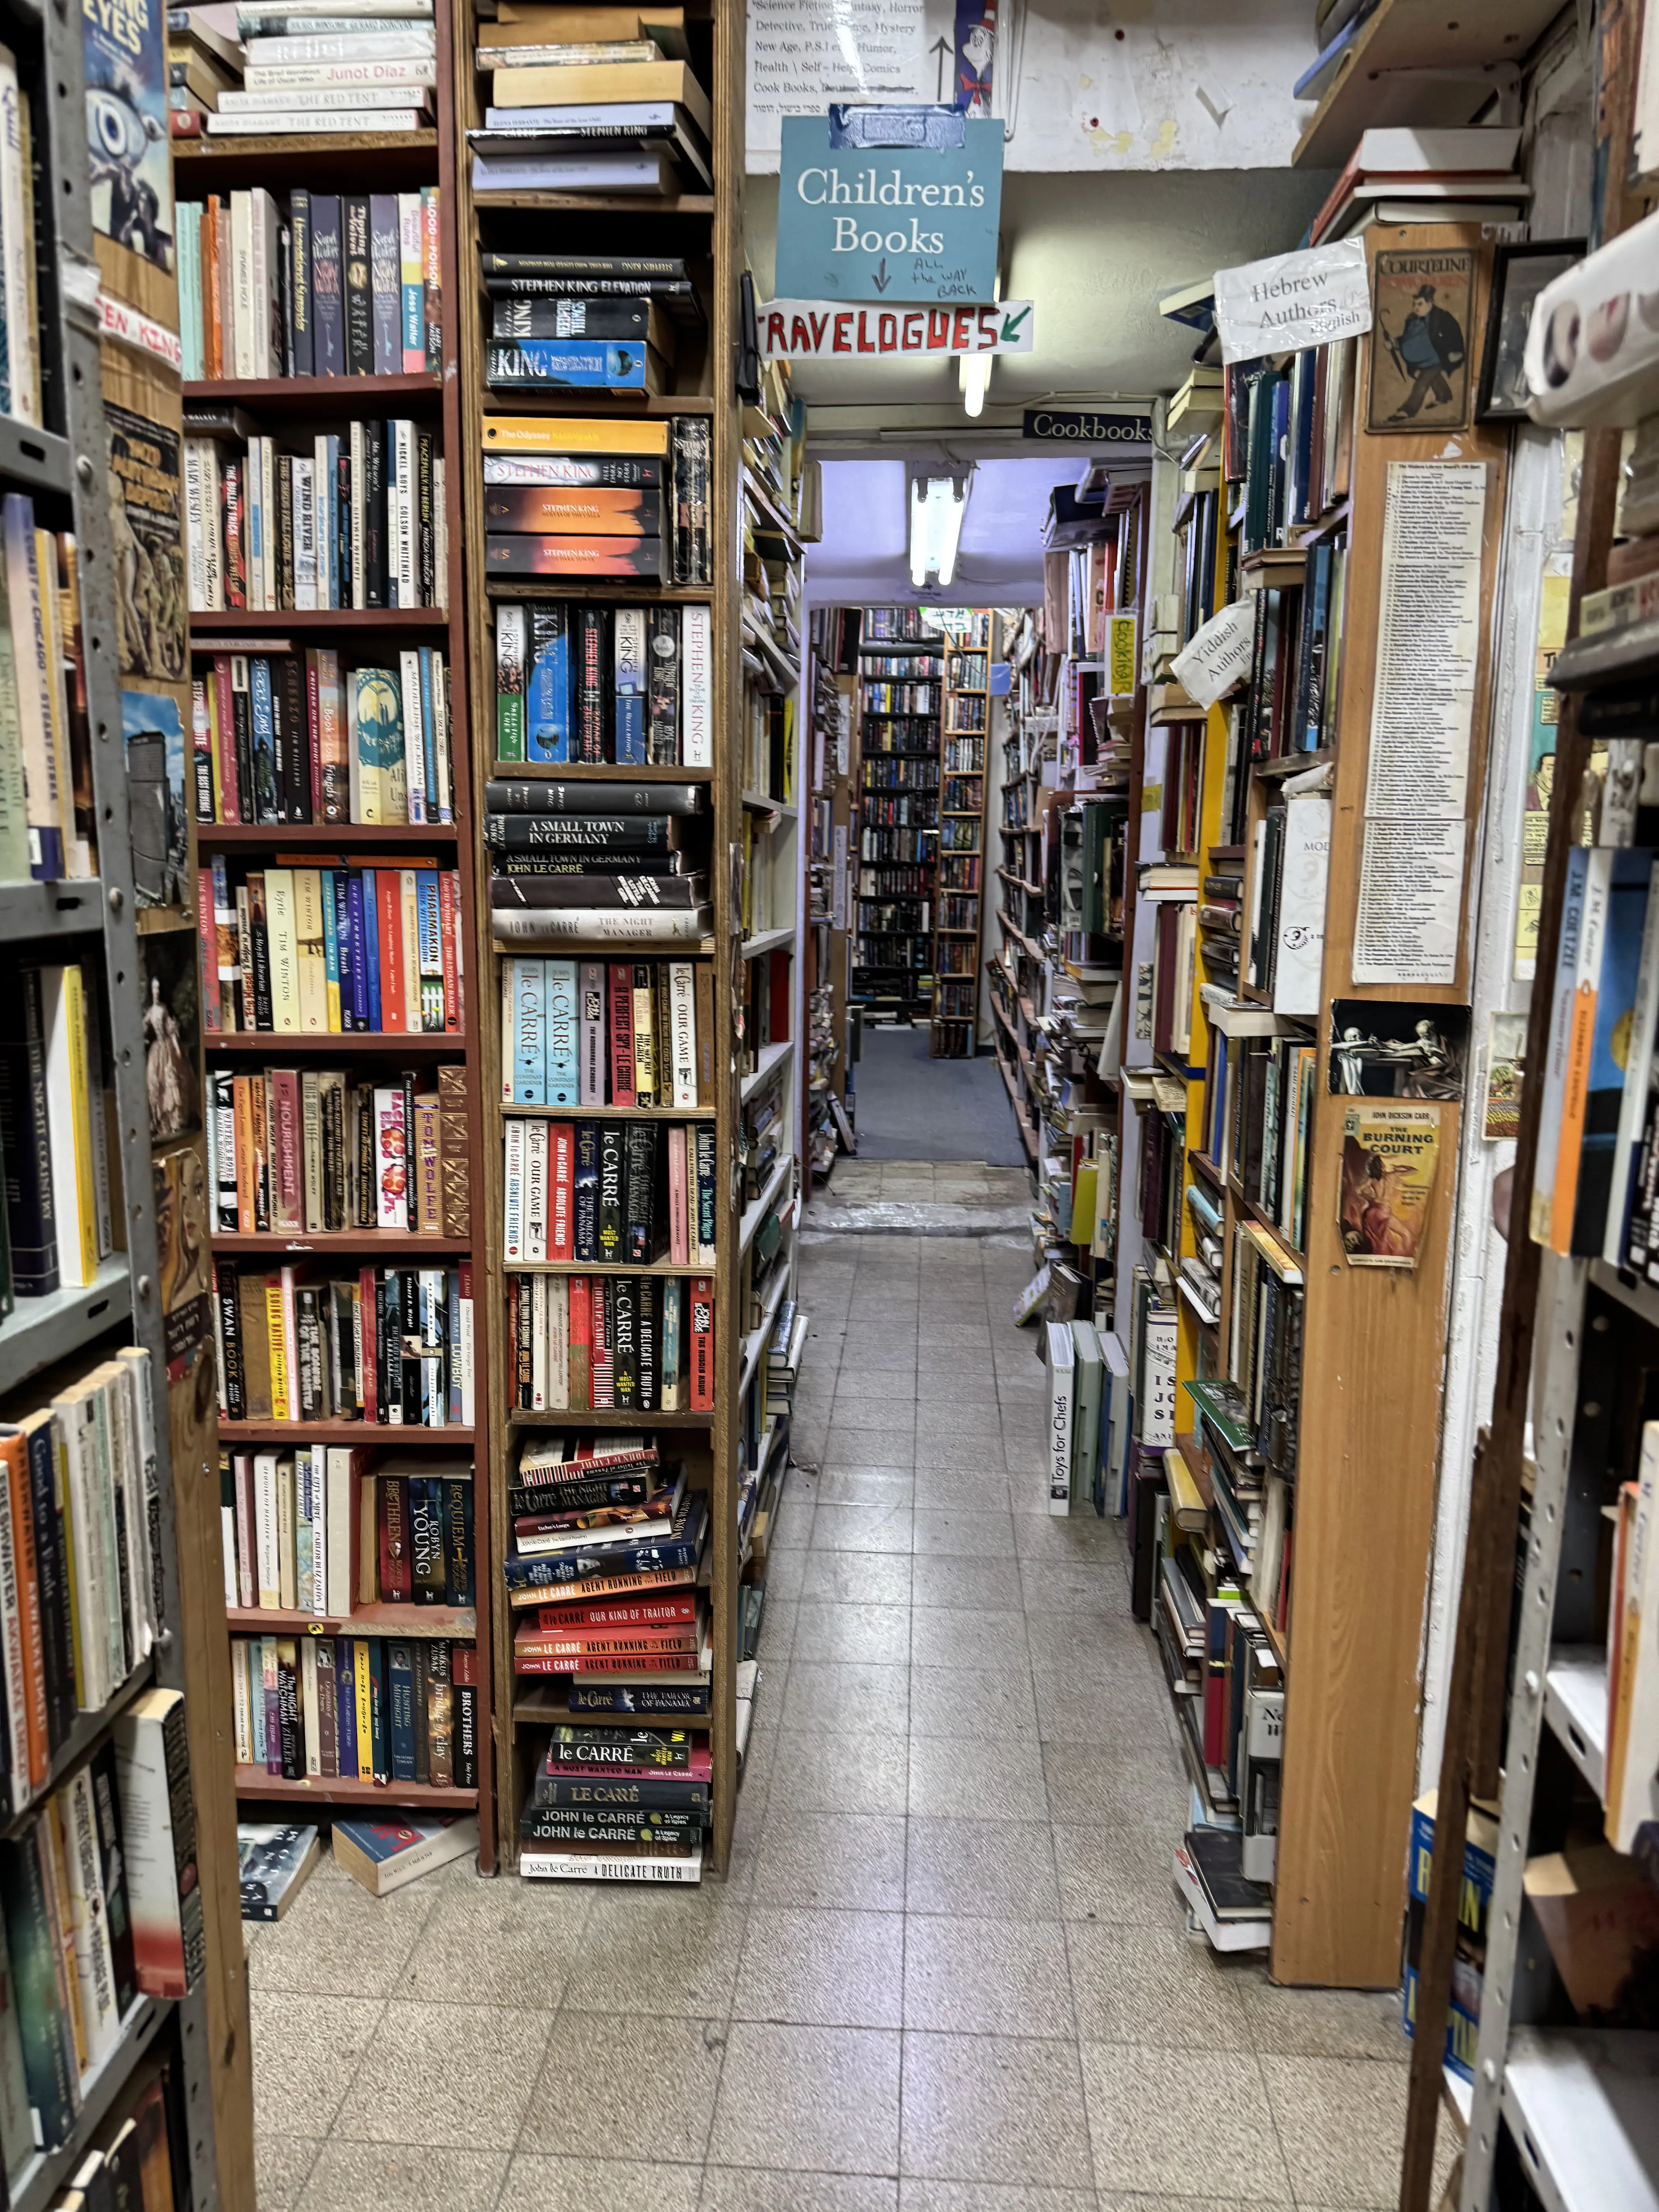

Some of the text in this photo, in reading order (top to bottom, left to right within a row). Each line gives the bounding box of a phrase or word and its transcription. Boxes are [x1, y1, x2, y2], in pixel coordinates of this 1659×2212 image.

[755, 60, 788, 72] Health
[754, 82, 779, 93] Cook
[798, 168, 985, 207] Children's
[831, 217, 944, 254] Books
[512, 279, 651, 295] STEPHEN KING ELEVATION
[937, 284, 977, 298] BACK
[1251, 271, 1328, 303] Hebrew
[513, 299, 532, 338] KING
[757, 306, 1001, 354] RAVELOGUES
[1259, 297, 1337, 330] Authors
[498, 349, 548, 377] KING
[497, 464, 595, 479] STEPHEN KING
[398, 441, 410, 584] NICKEL BOYS COLSON WHITEHEAD
[500, 632, 514, 671] KING
[533, 612, 558, 664] KING
[619, 636, 634, 674] KING
[1191, 620, 1238, 665] Yiddish
[692, 611, 704, 745] STEPHEN KING
[1207, 637, 1251, 682] Authors
[325, 764, 337, 798] Friends
[529, 821, 625, 832] A SMALL TOWN
[529, 833, 609, 845] IN GERMANY
[506, 855, 512, 863] A
[512, 855, 544, 863] SMALL
[545, 855, 577, 863] TOWN
[592, 855, 641, 864] GERMANY
[507, 864, 531, 874] JOHN
[534, 864, 547, 873] LE
[336, 882, 345, 899] TIM
[337, 901, 347, 941] WINTON
[426, 883, 439, 963] PHARMAKON
[599, 917, 654, 926] THE NIGHT
[603, 928, 654, 938] MANAGER
[276, 890, 290, 1001] Eyrie TIM WINTON
[520, 974, 541, 1055] le CARRÉ
[552, 977, 573, 1058] le CARRÉ
[677, 1003, 689, 1063] OUR GAME
[279, 1100, 295, 1196] NOURISHMENT
[1363, 1132, 1434, 1144] BURNING
[1369, 1144, 1424, 1155] COURT
[602, 1130, 620, 1207] le CARRÉ
[531, 1159, 541, 1218] OUR GAME
[617, 1279, 634, 1355] le CARRÉ
[222, 1297, 238, 1379] SWAN BOOK
[640, 1327, 653, 1364] DELICATE
[451, 1342, 463, 1389] LOWBOY
[640, 1365, 653, 1397] TRUTH
[1052, 1395, 1068, 1483] Toys for Chefs
[413, 1508, 431, 1575] YOUNG
[429, 1520, 441, 1559] ROBYN
[518, 1583, 577, 1601] JOHN LE CARRÉ
[581, 1575, 642, 1593] AGENT RUNNING
[655, 1571, 677, 1583] FIELD
[589, 1607, 676, 1623] OUR KIND OF TRAITOR
[438, 1640, 447, 1677] MARKUS
[544, 1644, 553, 1654] LE
[278, 1670, 289, 1725] WATCHMAN
[288, 1675, 297, 1723] The NIGHT
[393, 1683, 402, 1729] MIDNIGHT
[402, 1684, 412, 1728] HUNTING
[434, 1683, 446, 1725] bridge
[461, 1690, 473, 1755] BROTHERS
[434, 1740, 446, 1760] clay
[559, 1744, 634, 1762] le CARRÉ
[571, 1785, 640, 1802] LE CARRÉ
[532, 1826, 636, 1841] JOHN le CARRÉ
[542, 1810, 645, 1824] JOHN le CARRÉ
[601, 1864, 682, 1879] DELICATE TRUTH
